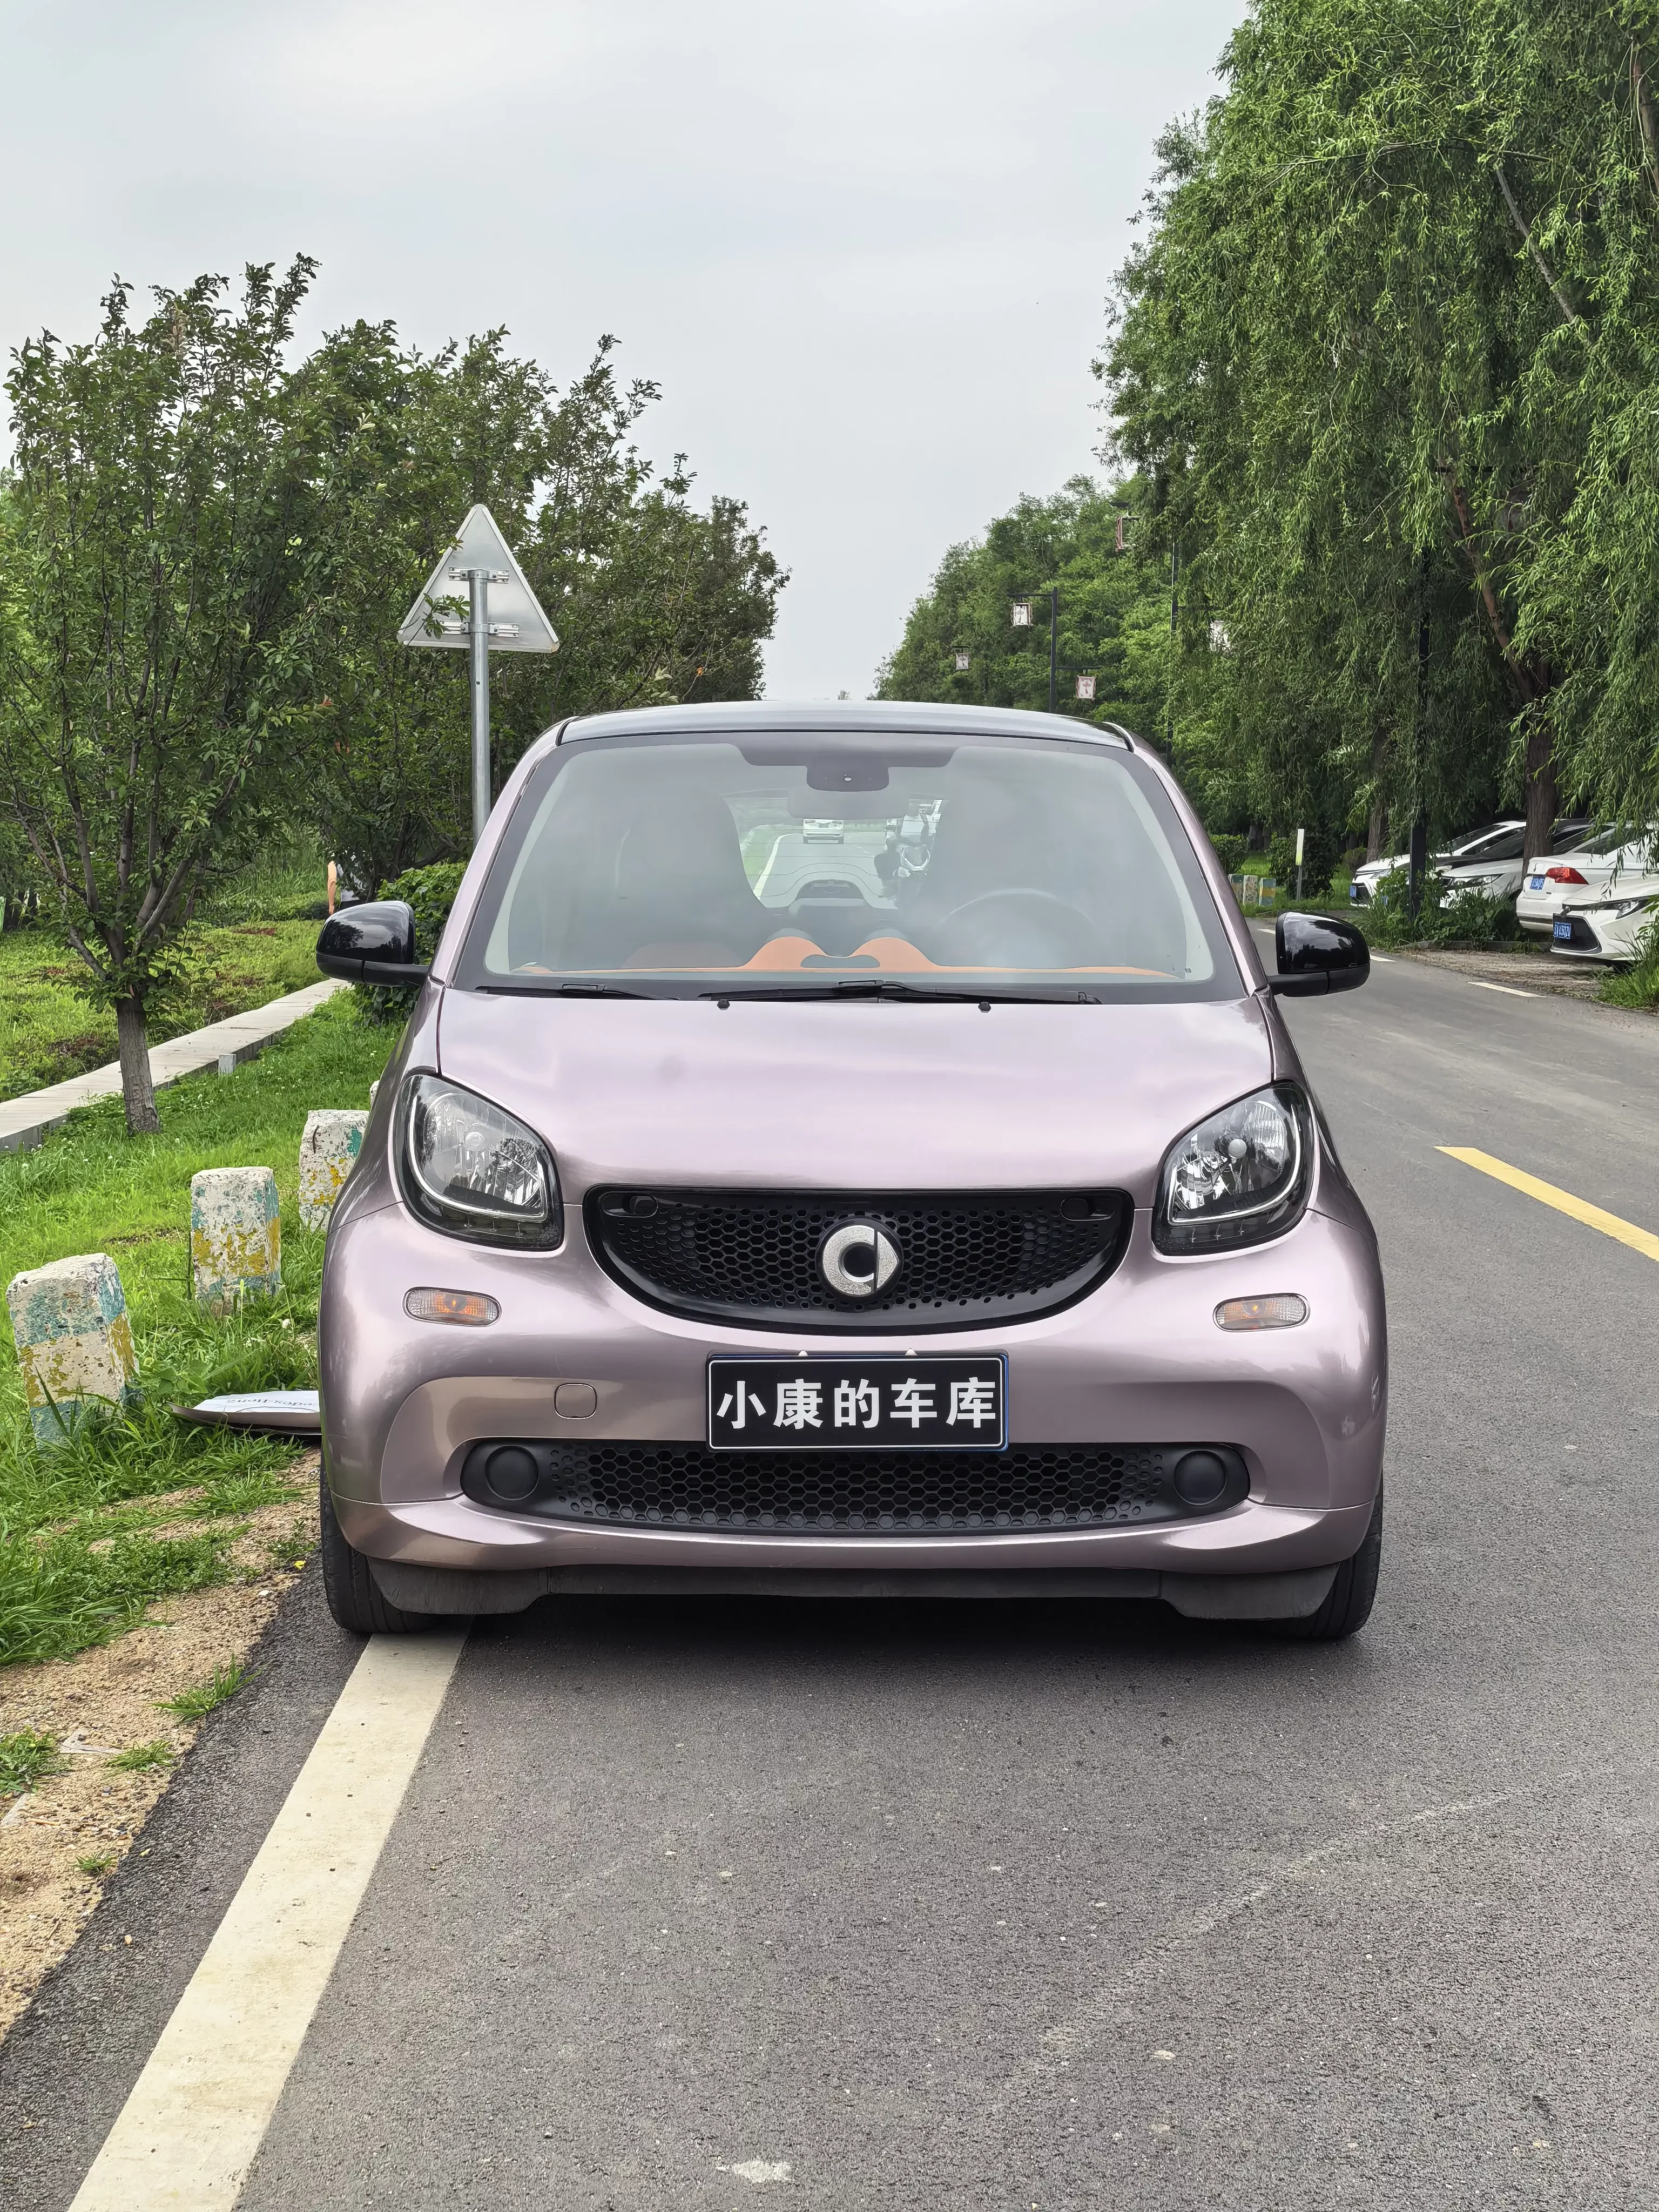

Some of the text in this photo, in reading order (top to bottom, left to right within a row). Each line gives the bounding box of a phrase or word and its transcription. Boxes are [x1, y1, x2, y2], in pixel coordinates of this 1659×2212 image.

[716, 1376, 996, 1429] 小康的车库
